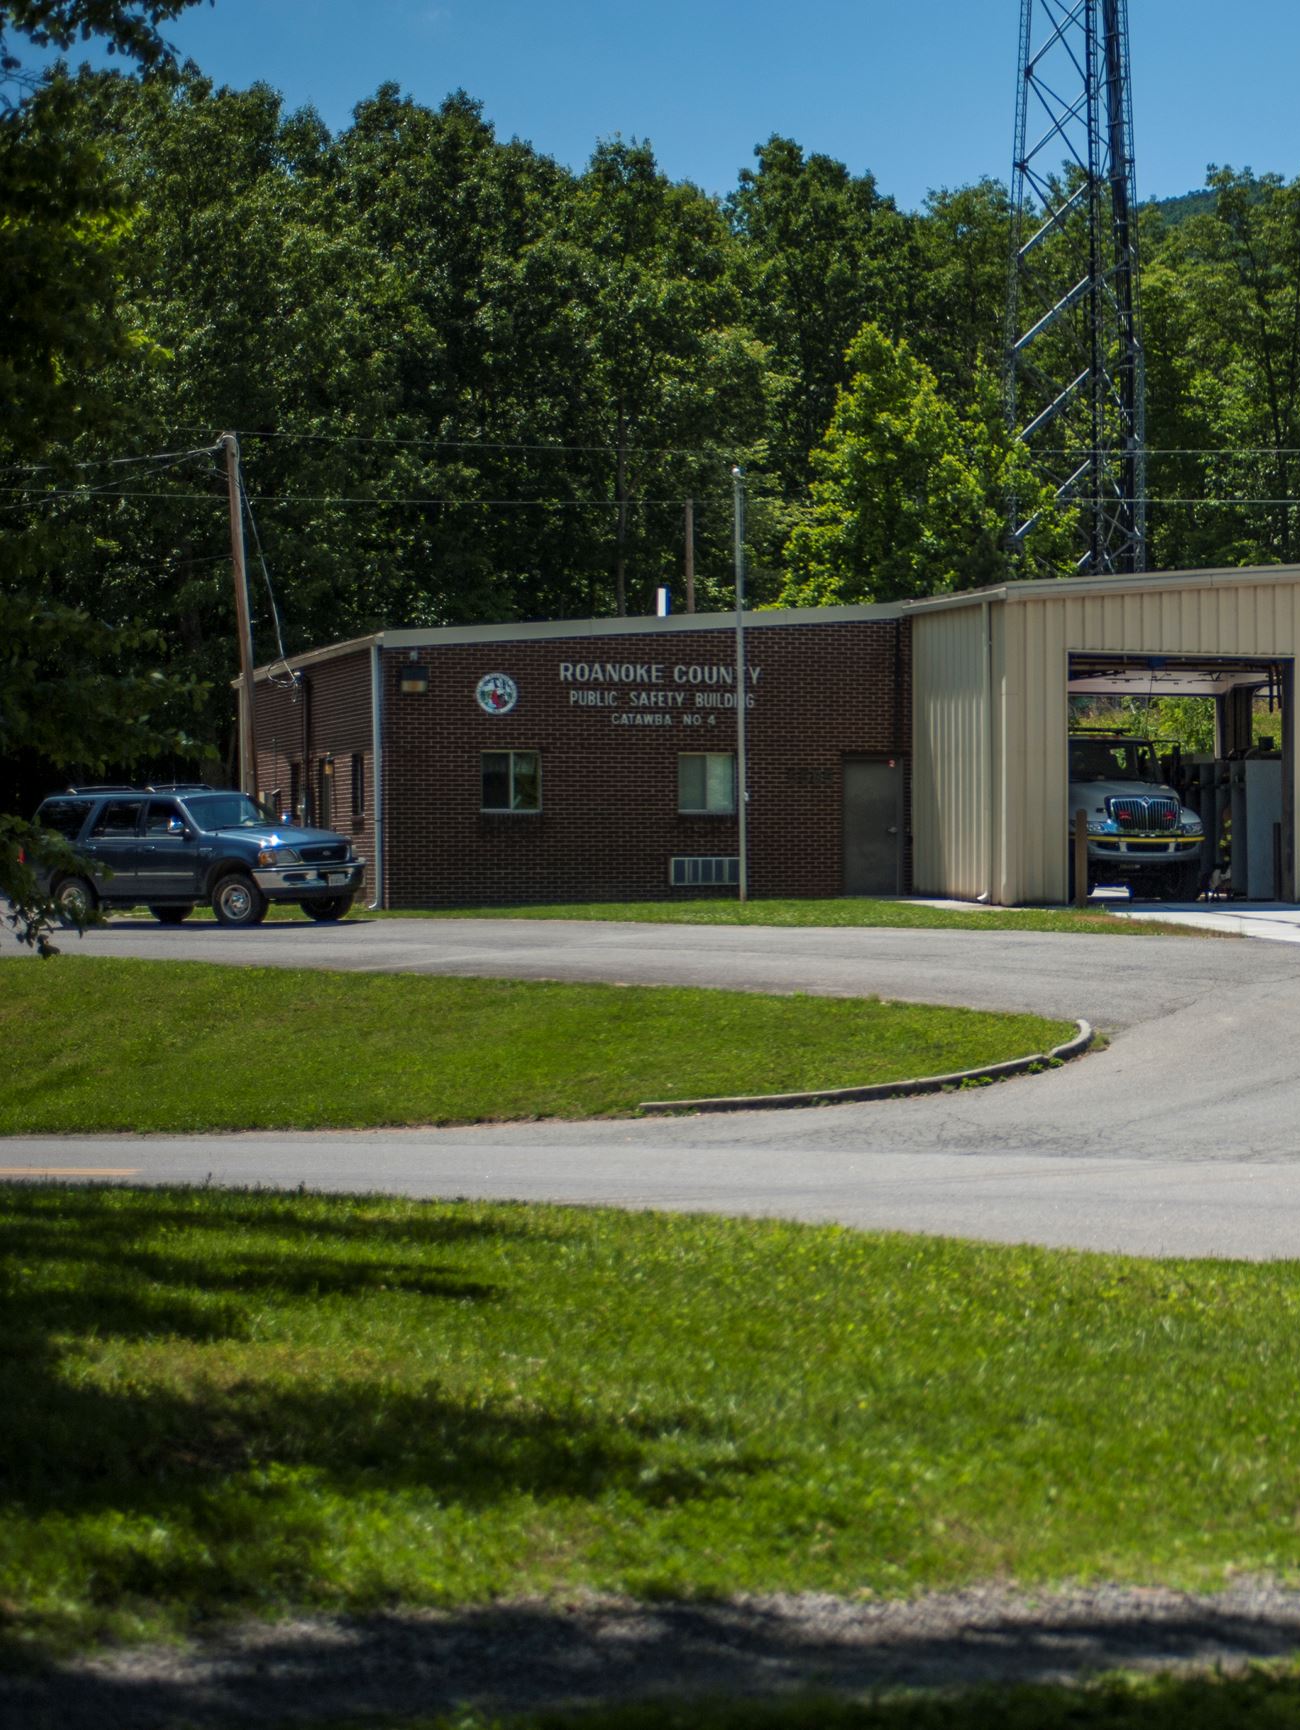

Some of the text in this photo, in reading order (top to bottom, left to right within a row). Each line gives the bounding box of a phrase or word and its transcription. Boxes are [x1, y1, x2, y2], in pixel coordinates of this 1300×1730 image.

[559, 662, 761, 684] ROANOKE COUNY
[569, 690, 755, 708] PUBLIC SAFETY BUILDIG
[611, 713, 716, 726] CATAWBA NO 4
